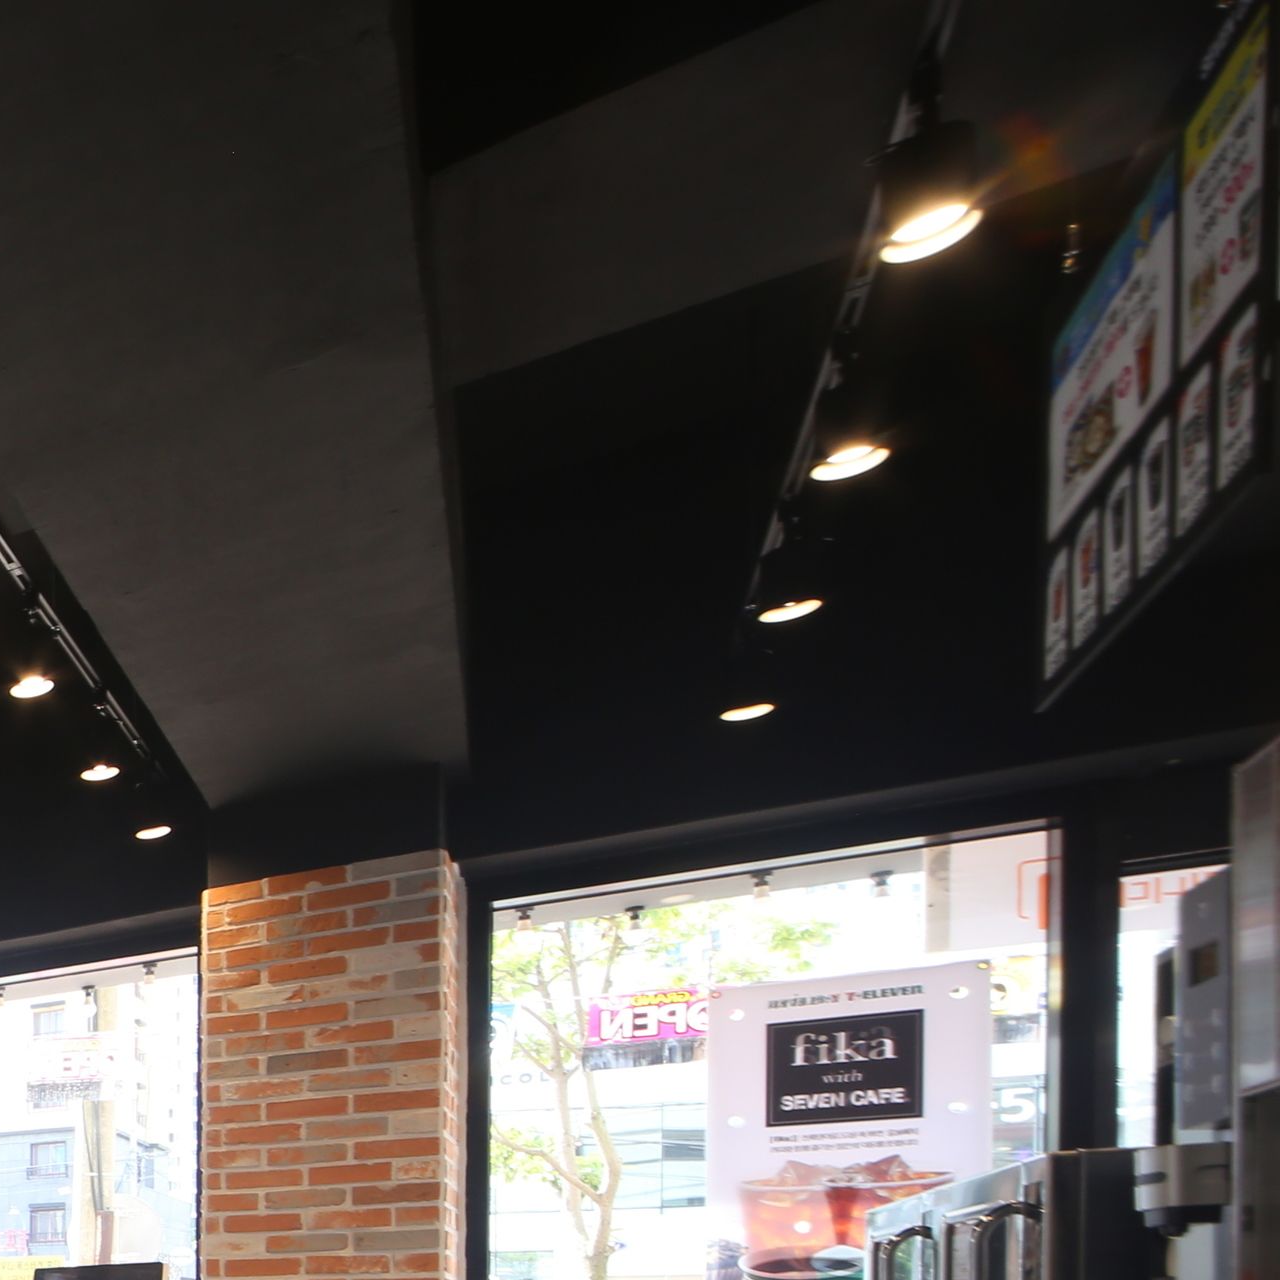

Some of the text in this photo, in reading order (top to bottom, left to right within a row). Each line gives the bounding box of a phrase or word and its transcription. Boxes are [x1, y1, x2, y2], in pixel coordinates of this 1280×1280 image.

[791, 1029, 898, 1067] fika
[822, 1069, 864, 1085] with
[780, 1086, 908, 1111] SEVEN CAFE
